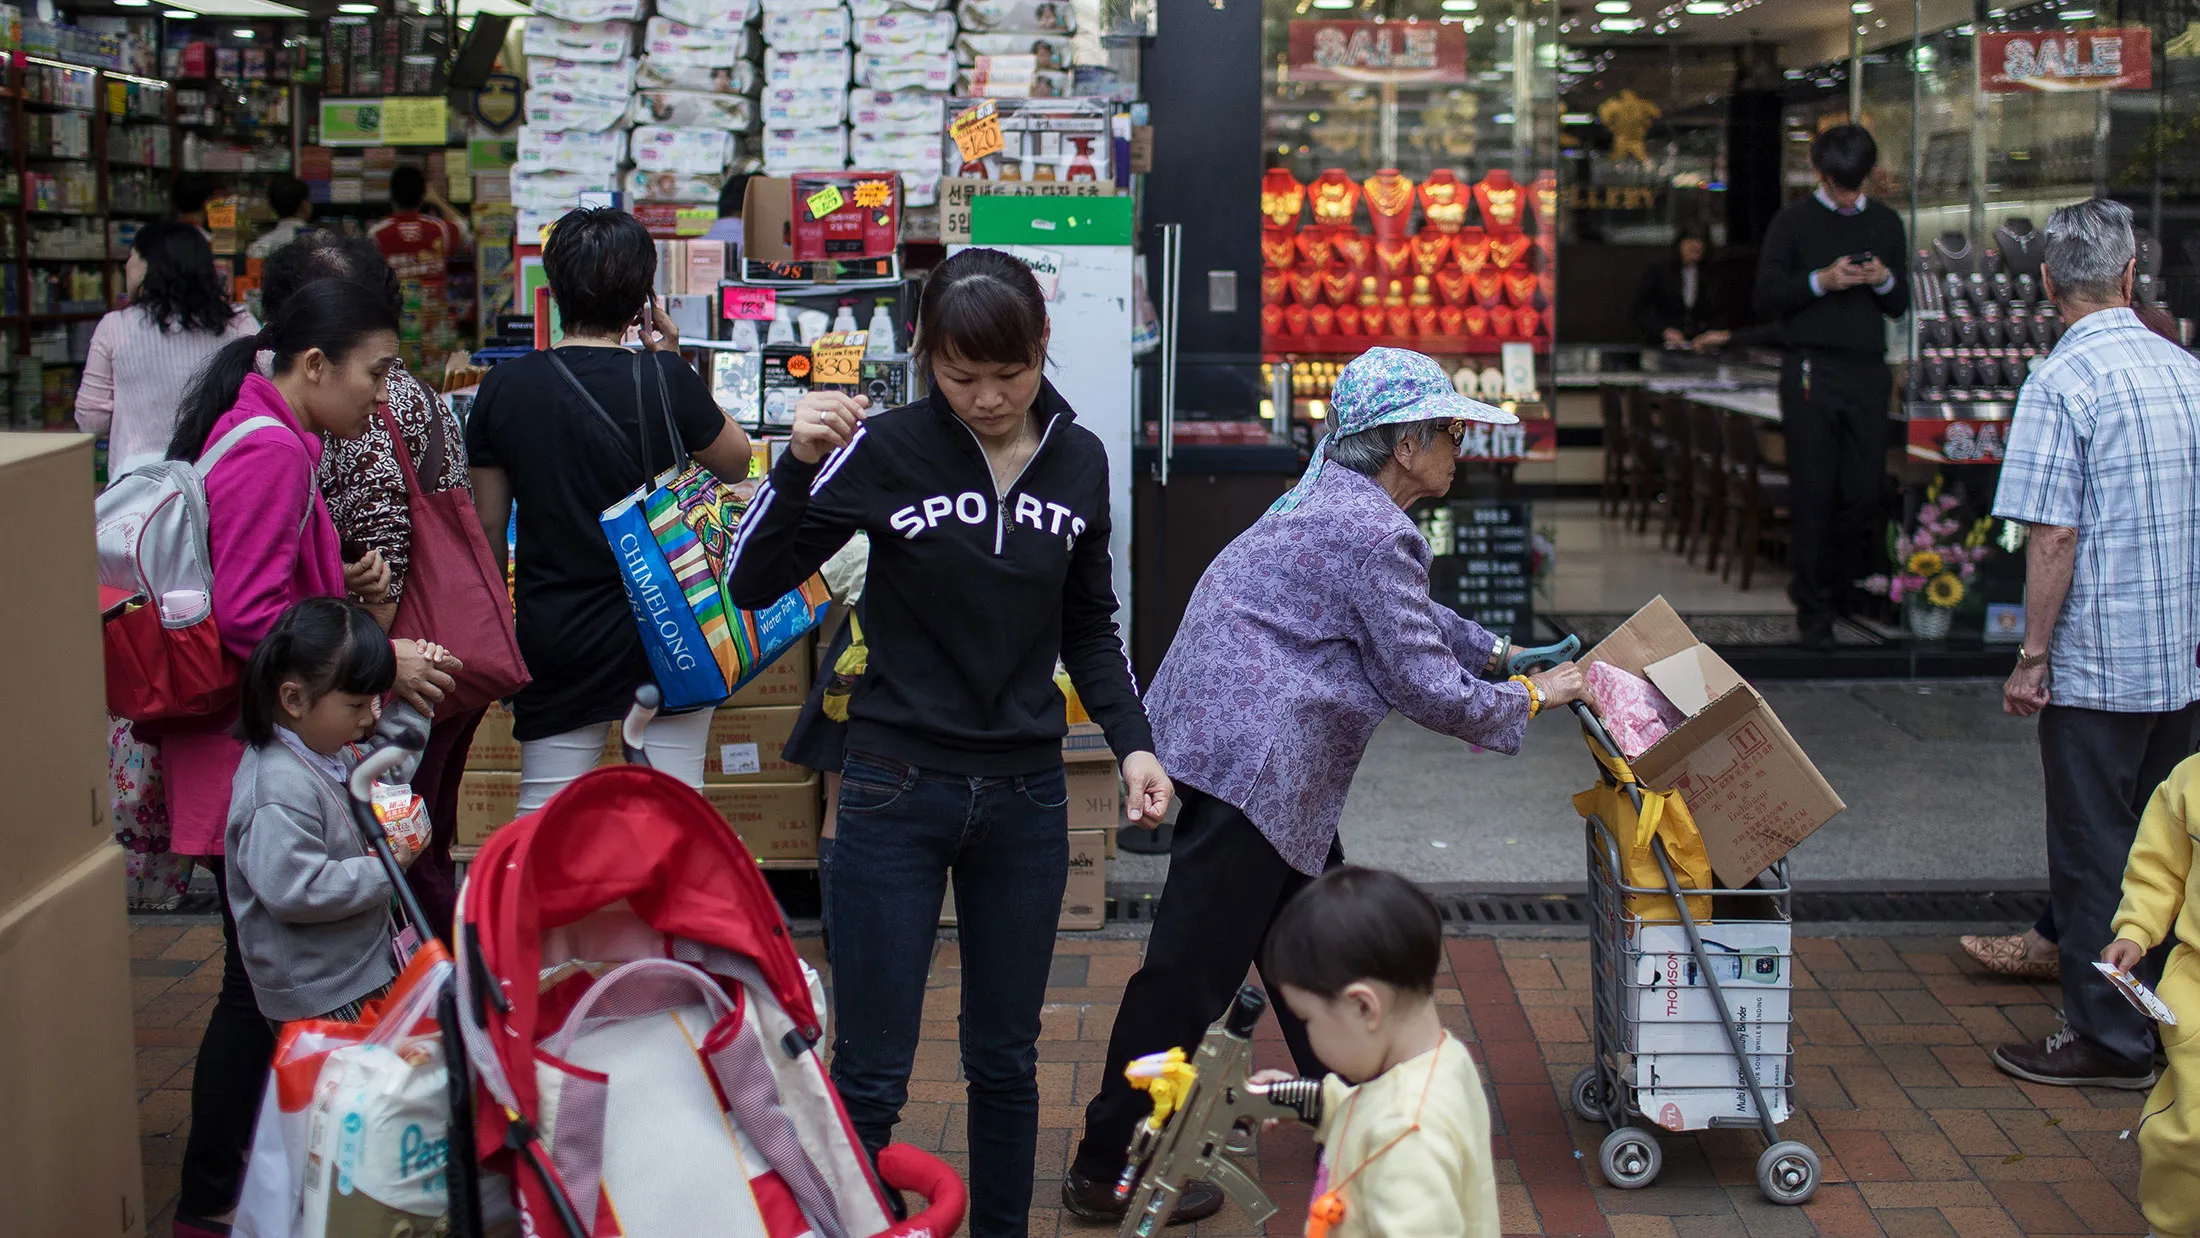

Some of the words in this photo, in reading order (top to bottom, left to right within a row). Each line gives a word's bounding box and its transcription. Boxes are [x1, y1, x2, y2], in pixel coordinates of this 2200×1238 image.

[1313, 27, 1437, 69] SALE
[2002, 36, 2123, 80] SALE
[1944, 421, 2010, 461] SA
[620, 533, 696, 671] CHIMELONG
[760, 611, 781, 635] Water
[781, 597, 797, 616] Park
[1069, 859, 1093, 868] alch
[1667, 950, 1678, 1017] THOMSON
[1667, 1106, 1677, 1129] 1.7L
[1736, 1093, 1746, 1112] Multi
